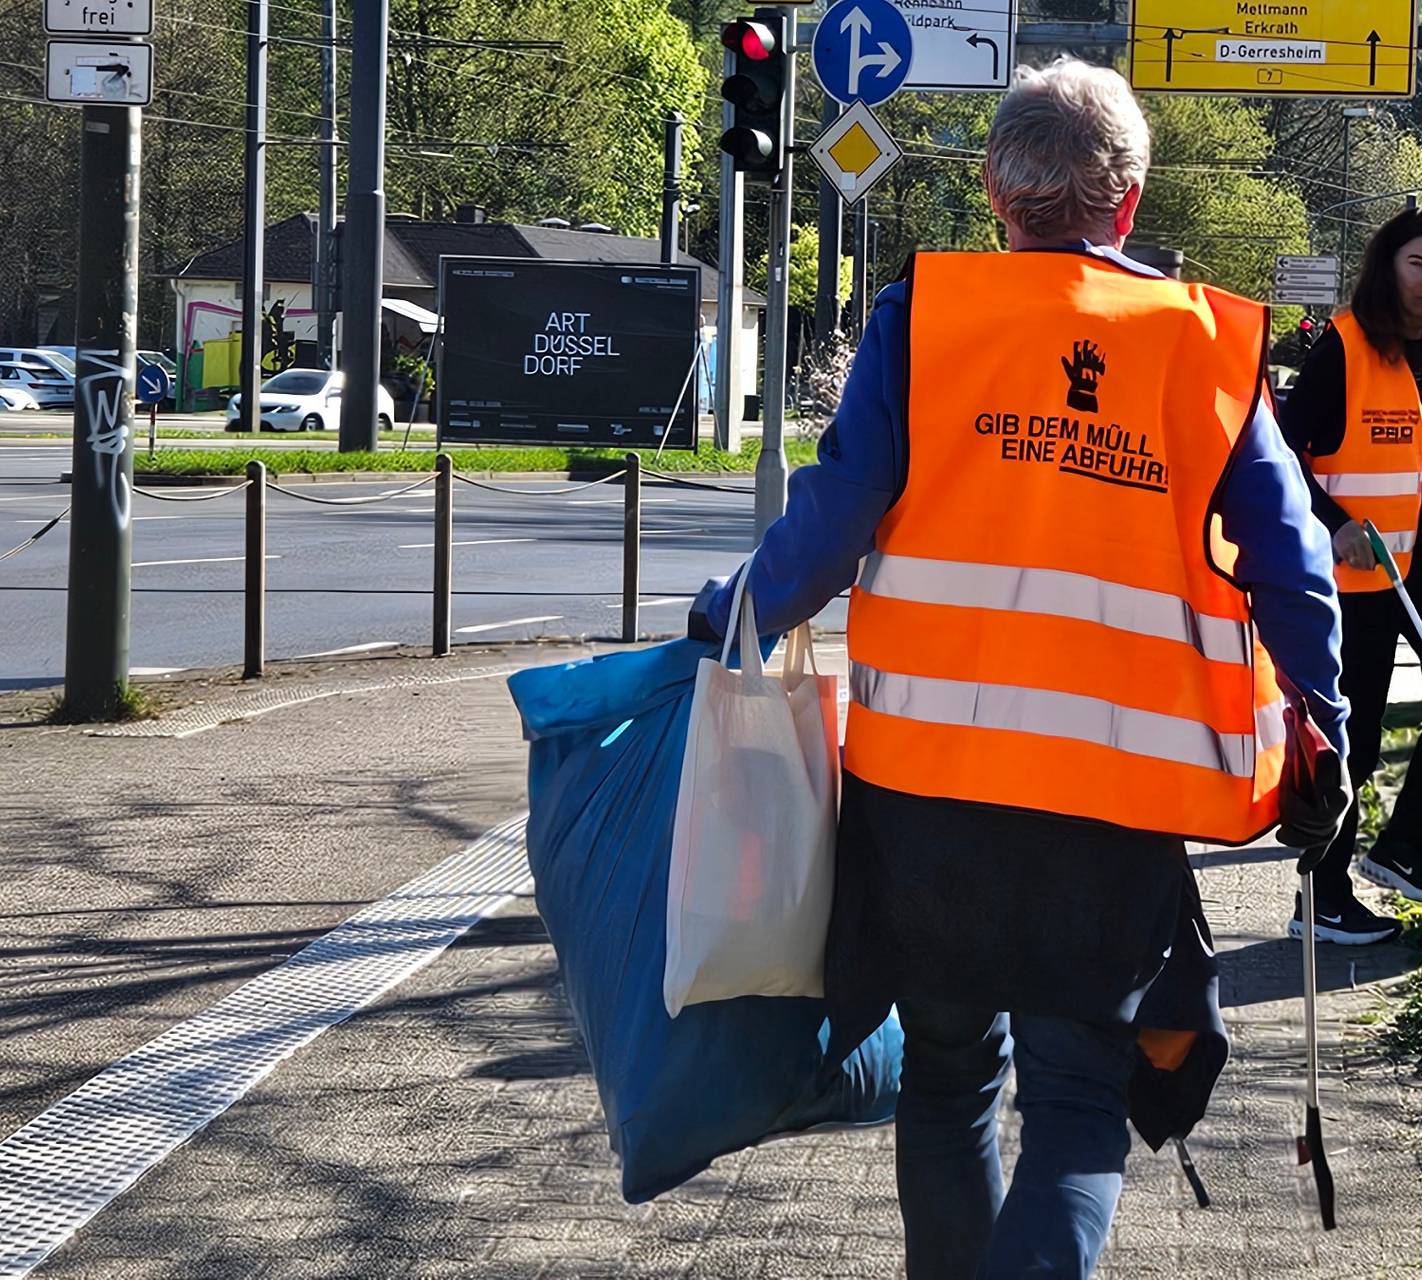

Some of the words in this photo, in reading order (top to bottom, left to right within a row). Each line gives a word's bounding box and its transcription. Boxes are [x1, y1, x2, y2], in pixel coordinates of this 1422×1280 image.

[894, 0, 963, 9] ennbahn
[1237, 3, 1308, 15] Mettmann
[83, 6, 115, 25] frei
[907, 14, 955, 29] ldpark
[1245, 21, 1298, 34] Erkrath
[1220, 44, 1322, 59] D-Gerresheim
[1266, 71, 1273, 82] 7
[545, 312, 591, 333] ART
[524, 355, 584, 376] DORF
[975, 413, 1020, 435] GIB
[1028, 415, 1080, 441] DEM
[1086, 423, 1153, 458] MÜLL
[1001, 438, 1057, 463] EINE
